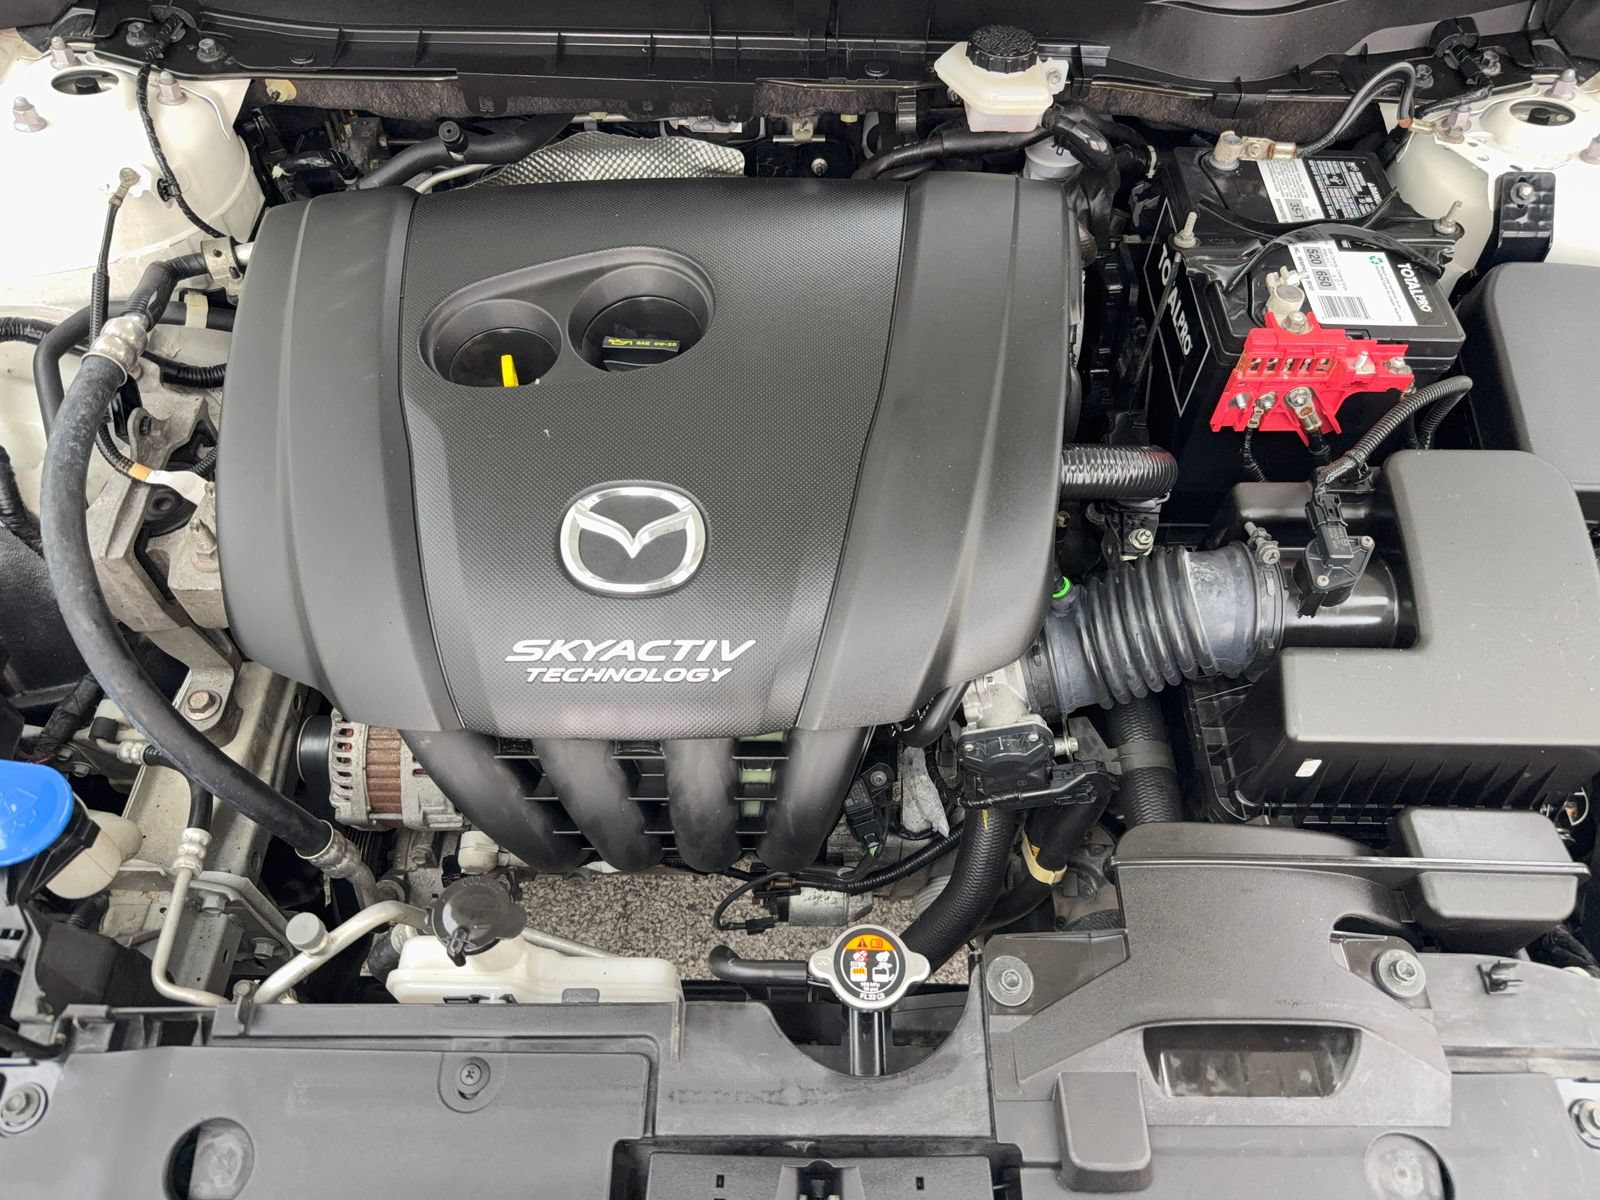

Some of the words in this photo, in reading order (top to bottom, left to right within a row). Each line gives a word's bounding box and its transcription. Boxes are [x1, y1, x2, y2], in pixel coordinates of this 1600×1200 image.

[1289, 202, 1305, 219] 35-T
[1306, 248, 1322, 264] 520
[1315, 271, 1331, 287] 650
[1158, 243, 1193, 355] TOALPRO
[1397, 263, 1432, 312] TOTALPRO
[504, 639, 757, 662] SKYACTIV
[526, 667, 733, 682] TECHNOLOGY
[859, 992, 876, 1000] FL22
